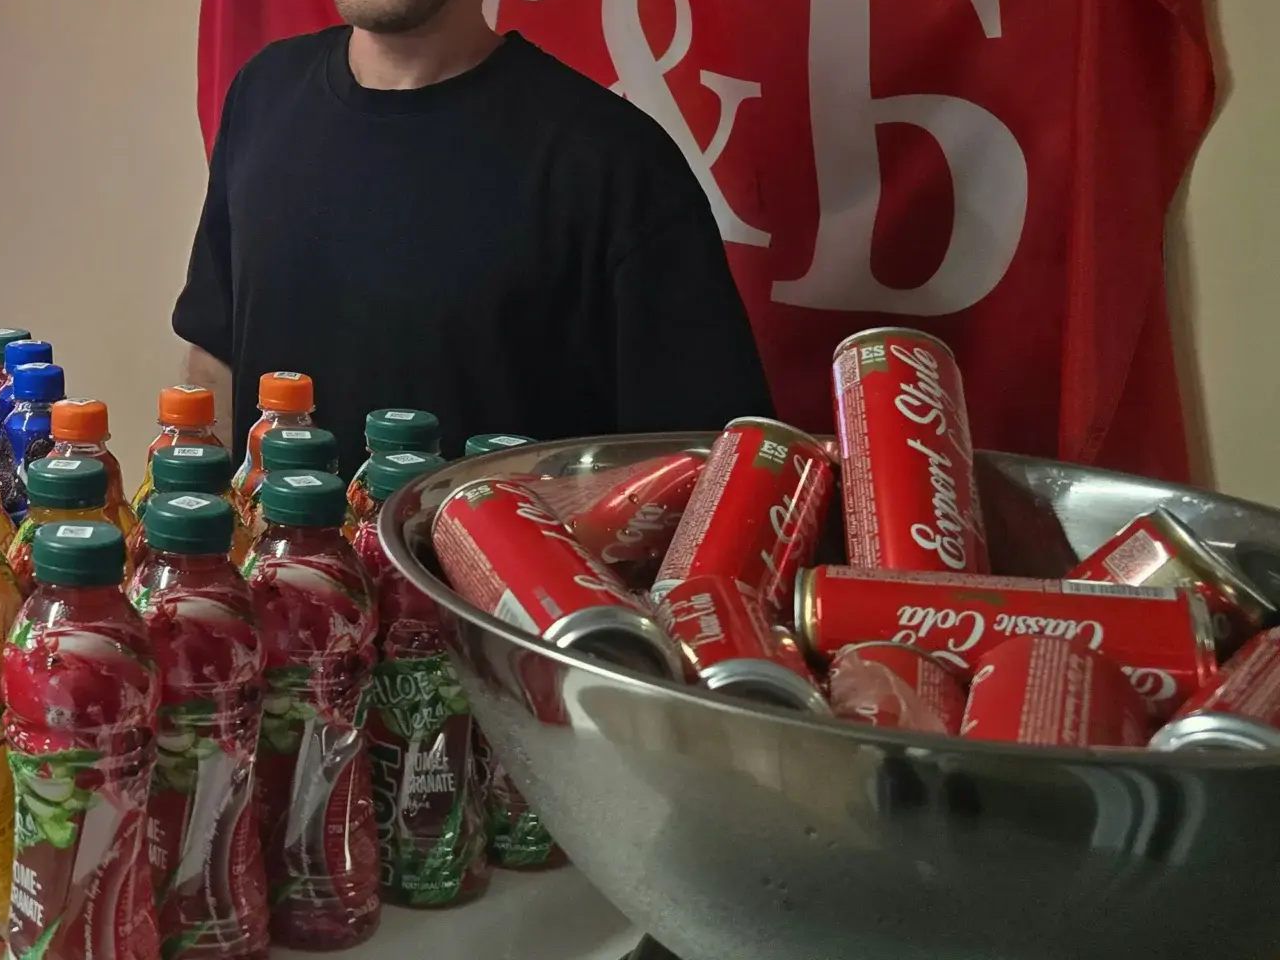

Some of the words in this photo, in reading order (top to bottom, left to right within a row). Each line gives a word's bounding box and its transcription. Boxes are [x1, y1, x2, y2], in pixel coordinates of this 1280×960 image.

[759, 440, 788, 459] ES
[897, 605, 985, 652] Cola
[366, 671, 435, 704] ALOE
